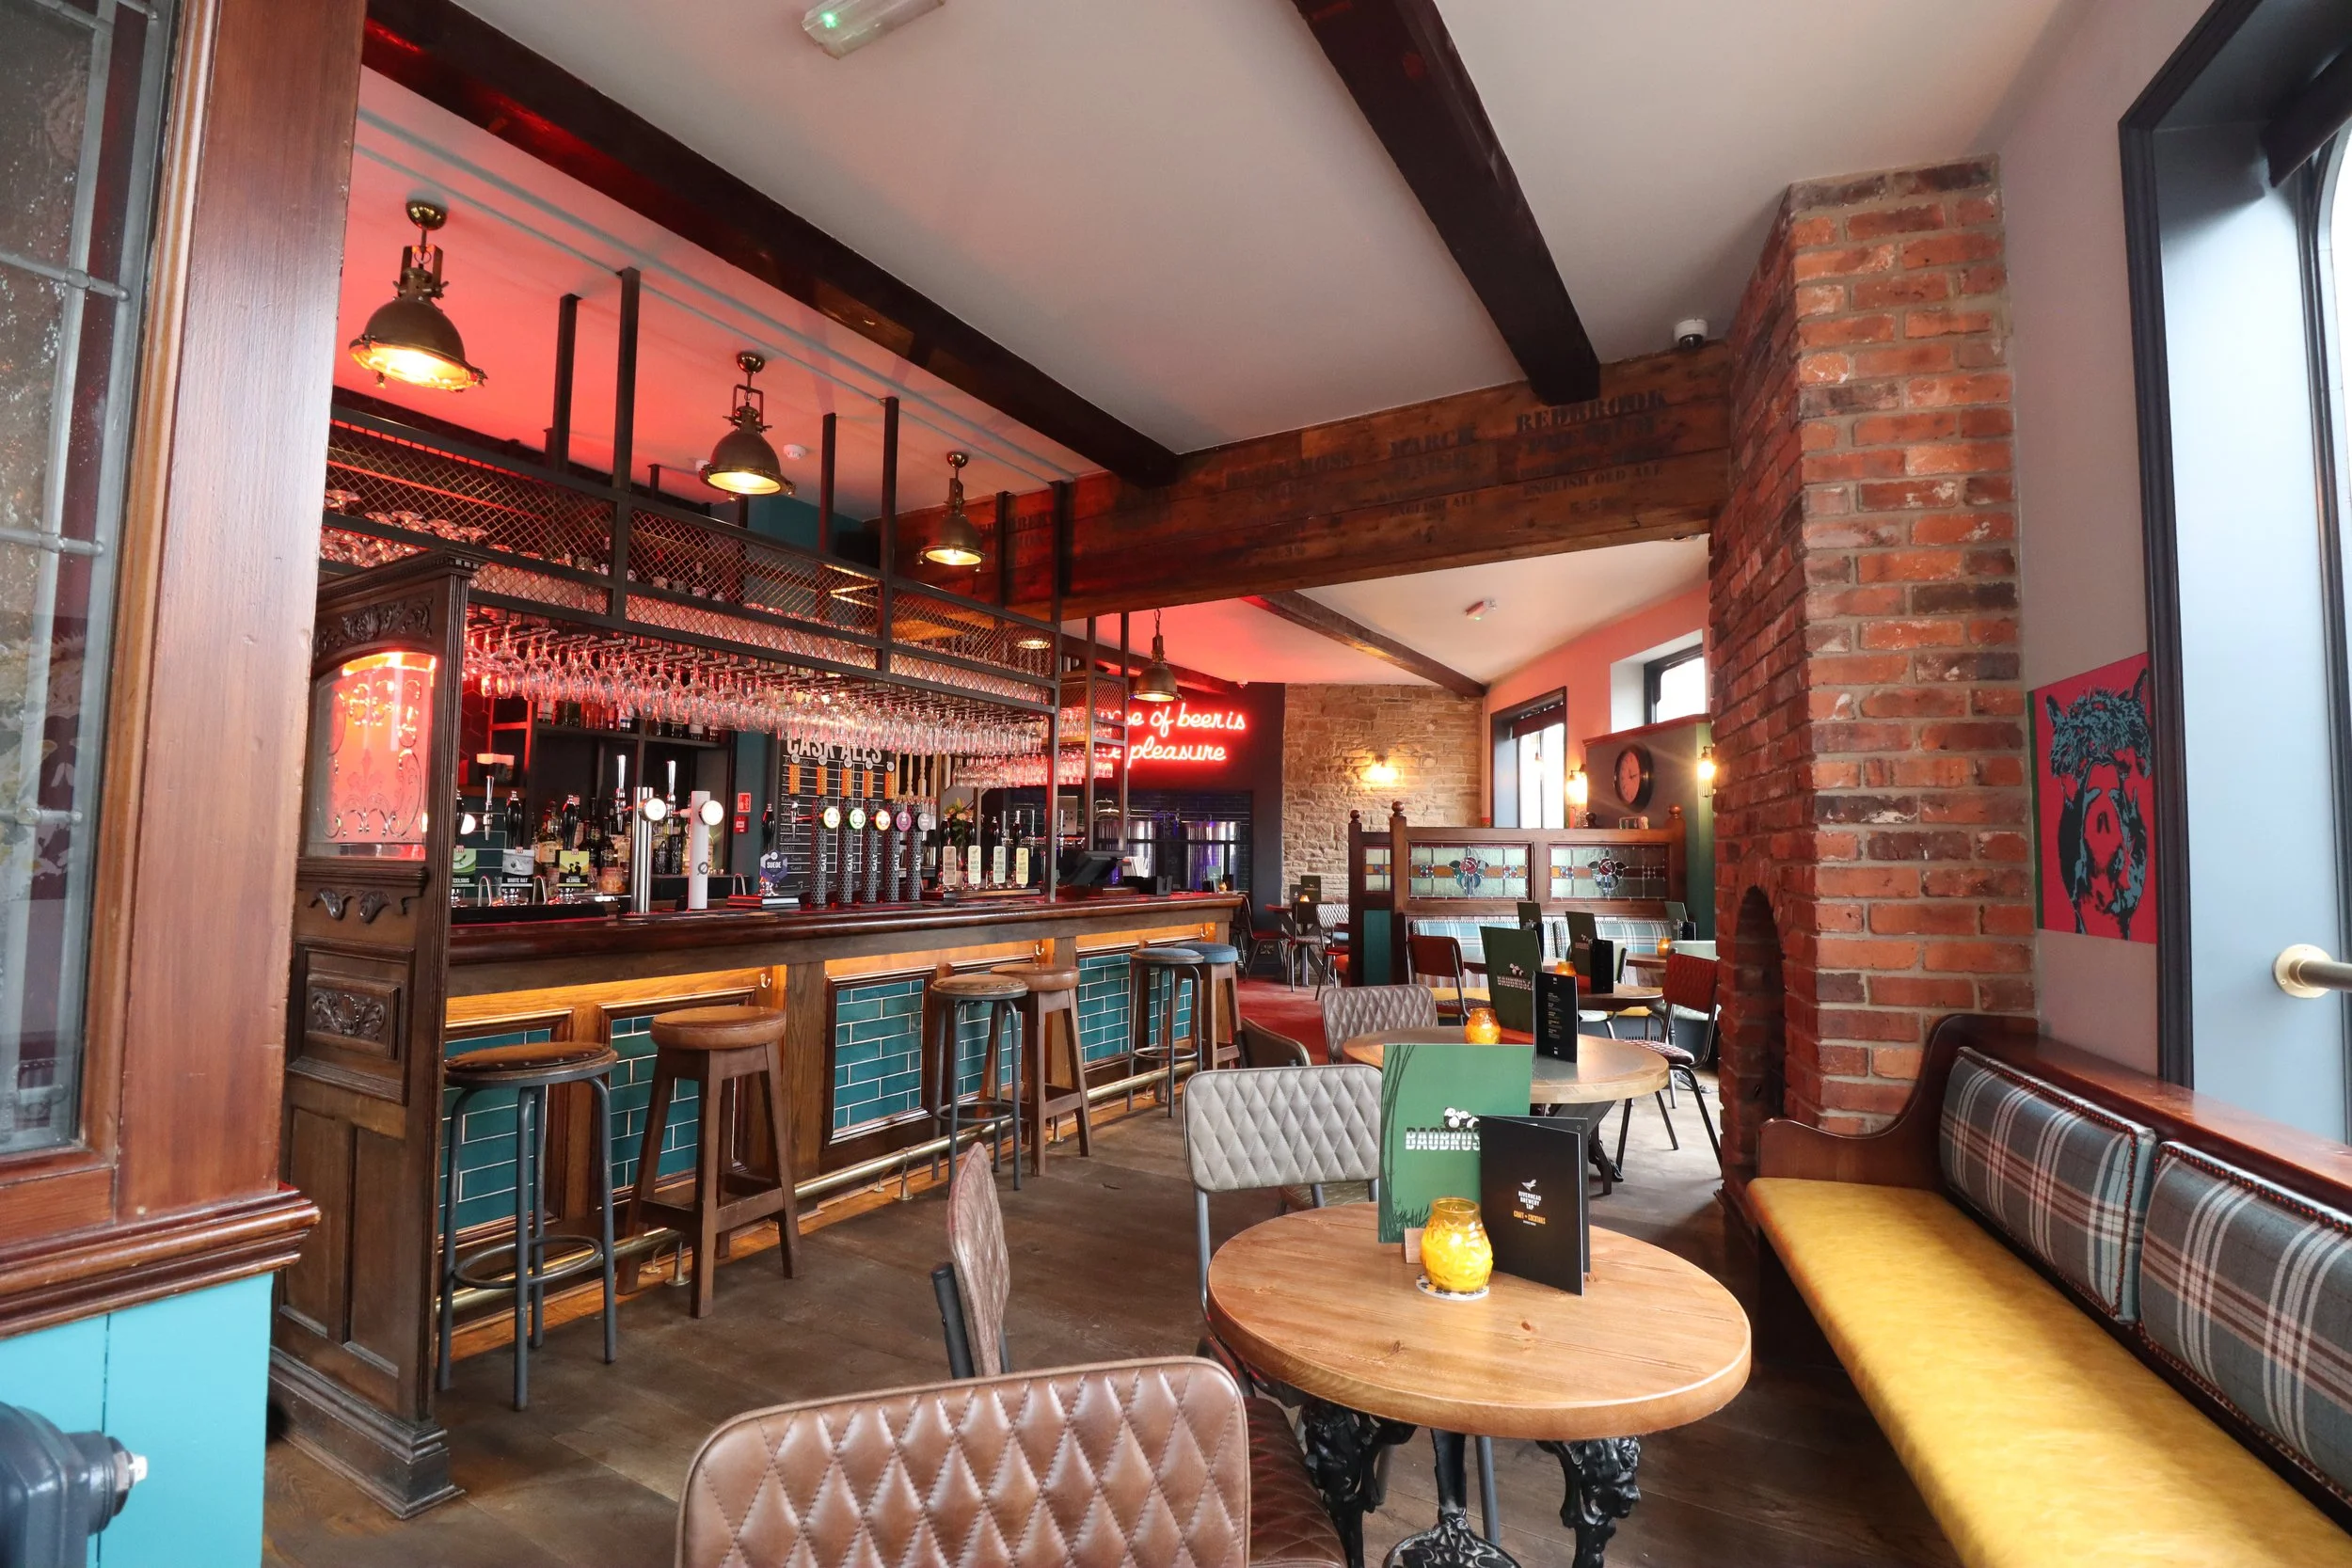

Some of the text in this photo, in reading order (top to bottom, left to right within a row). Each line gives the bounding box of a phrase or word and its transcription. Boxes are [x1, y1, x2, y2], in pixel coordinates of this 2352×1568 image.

[1150, 705, 1174, 737] of
[1177, 703, 1222, 730] beer
[1226, 710, 1247, 731] is
[787, 736, 882, 764] CASK ALES
[1126, 736, 1226, 768] pleasure
[766, 861, 782, 869] SUEDE
[1519, 1196, 1540, 1207] BREWERY
